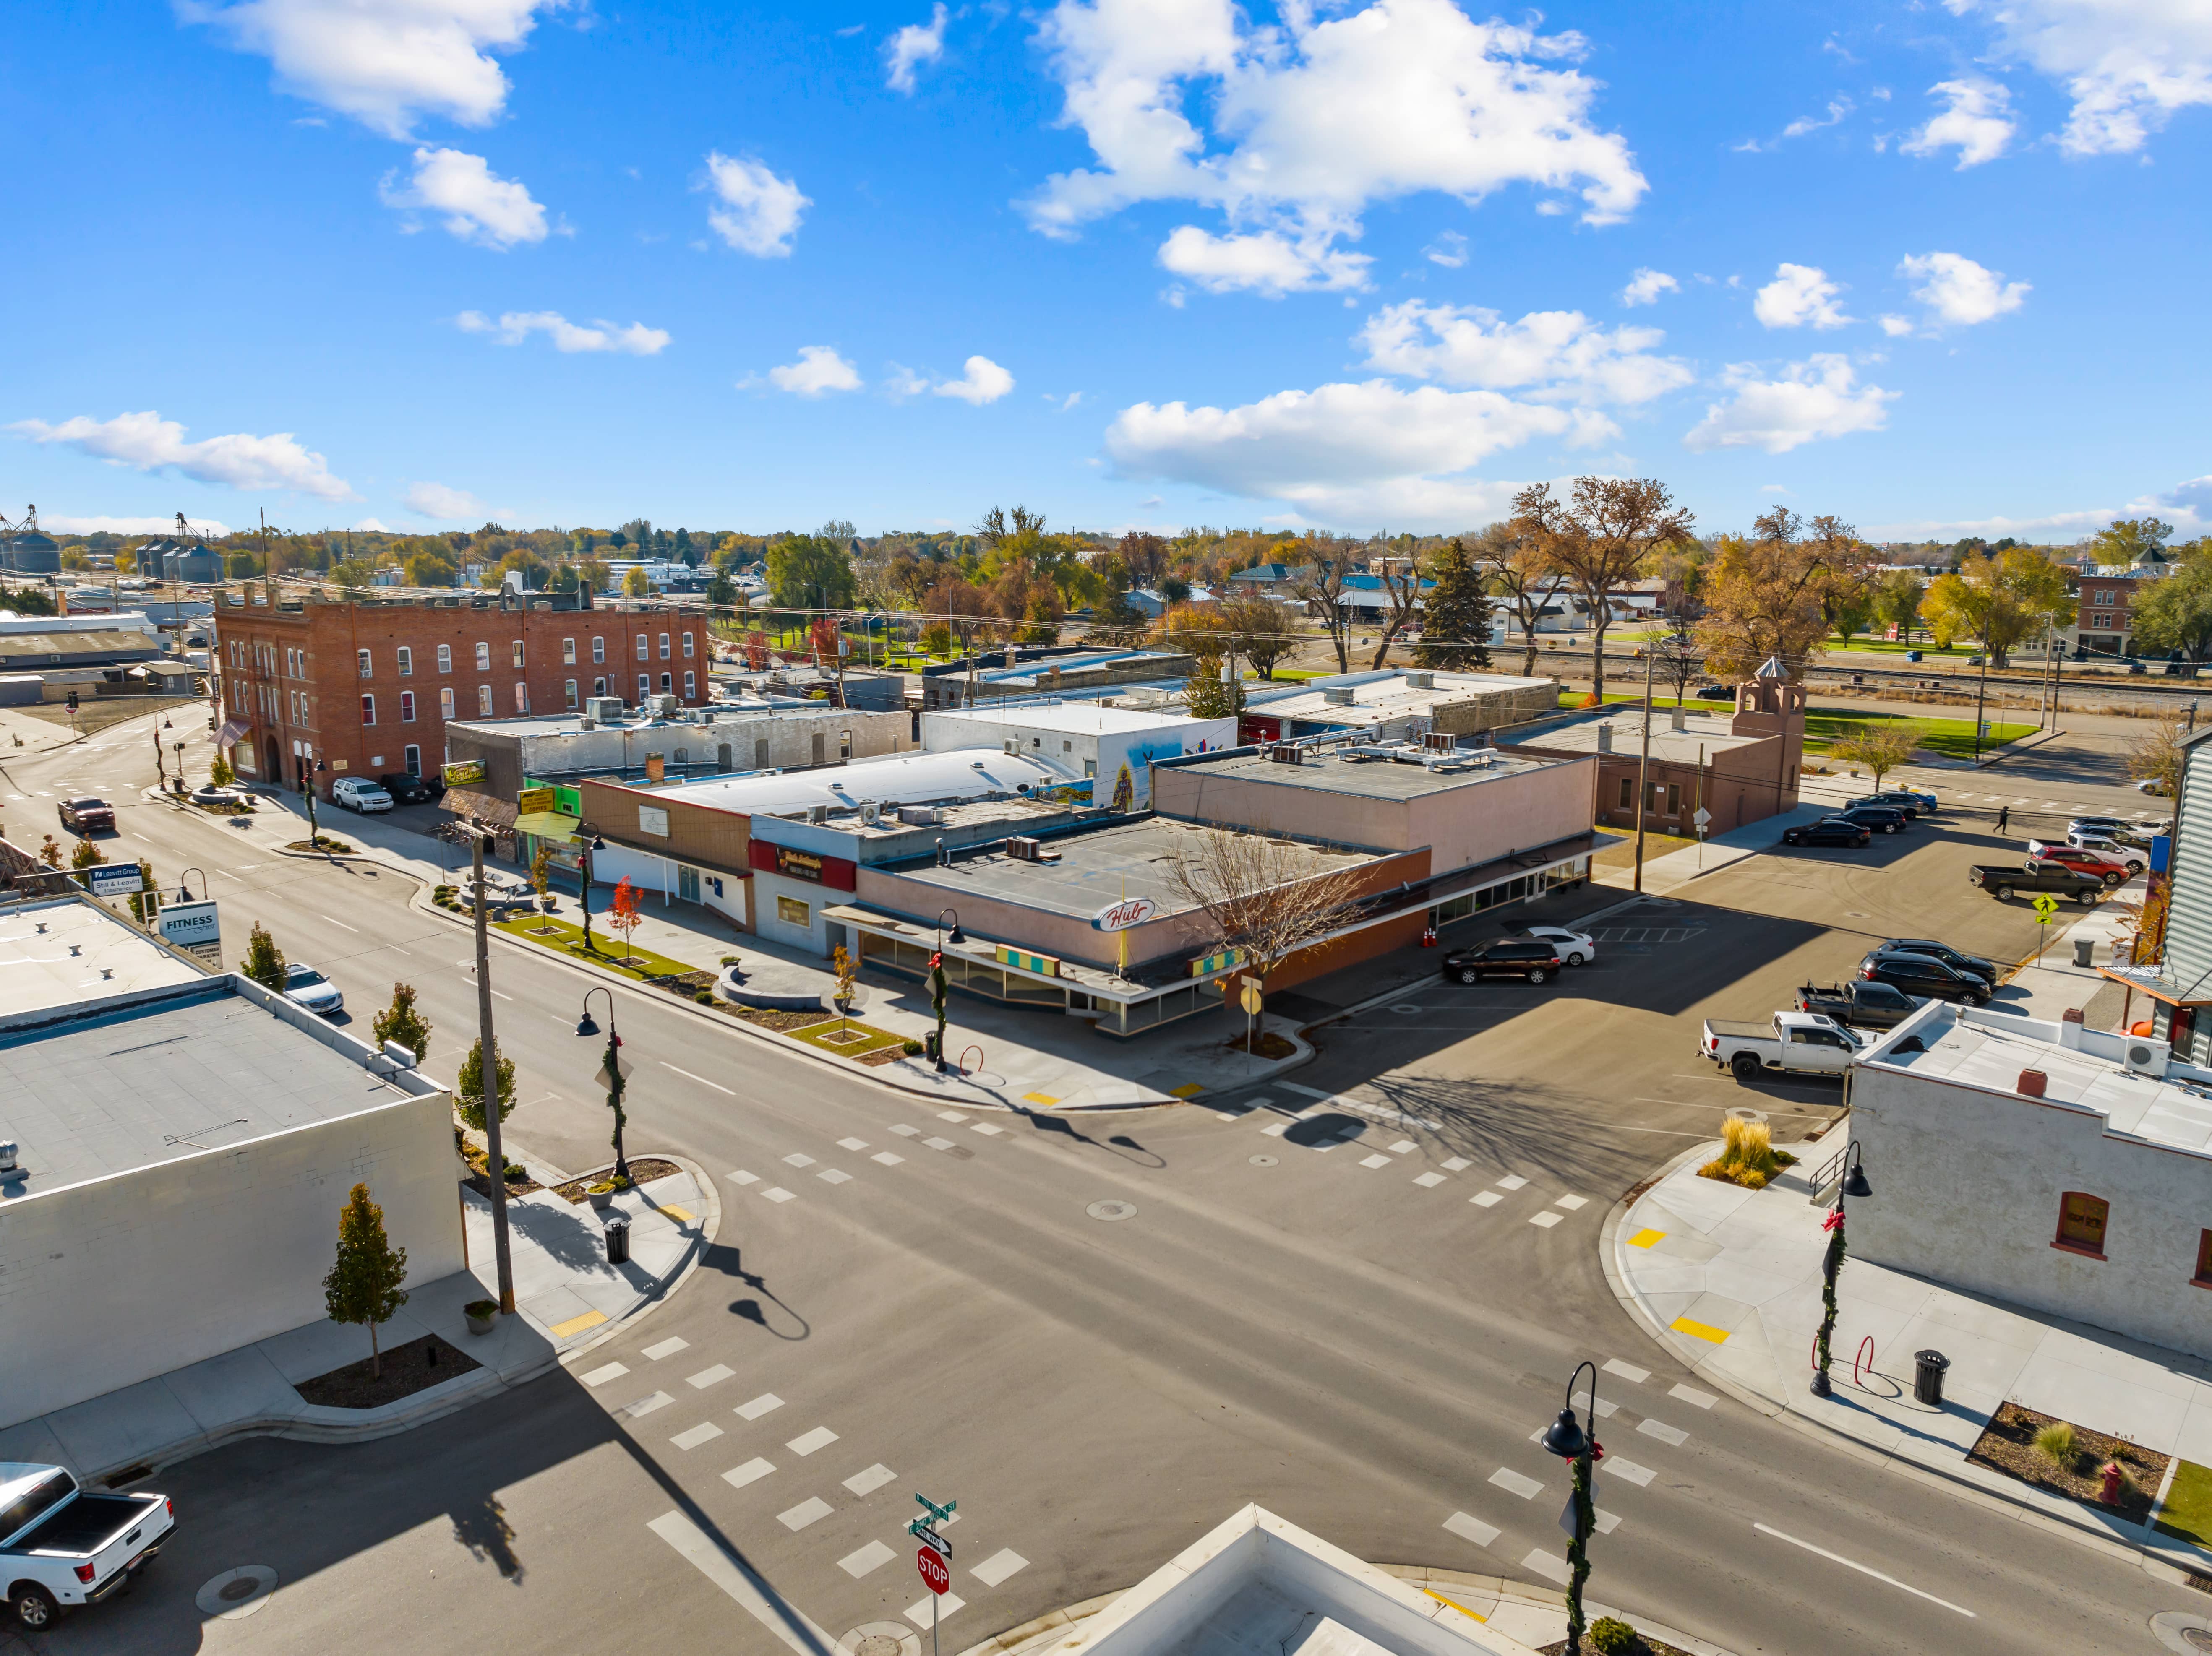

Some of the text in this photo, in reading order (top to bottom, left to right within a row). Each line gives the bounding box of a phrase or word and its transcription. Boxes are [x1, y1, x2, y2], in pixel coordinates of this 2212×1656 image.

[449, 768, 481, 781] Mi Casa
[167, 915, 213, 930] FITNESS
[1106, 902, 1148, 928] Hub
[194, 923, 215, 934] First
[910, 1526, 913, 1534] E
[916, 1518, 927, 1531] 2ND
[949, 1502, 956, 1510] ST
[931, 1504, 941, 1515] EAST
[943, 1511, 947, 1520] ST
[929, 1534, 940, 1546] WAY
[919, 1555, 947, 1584] STOP
